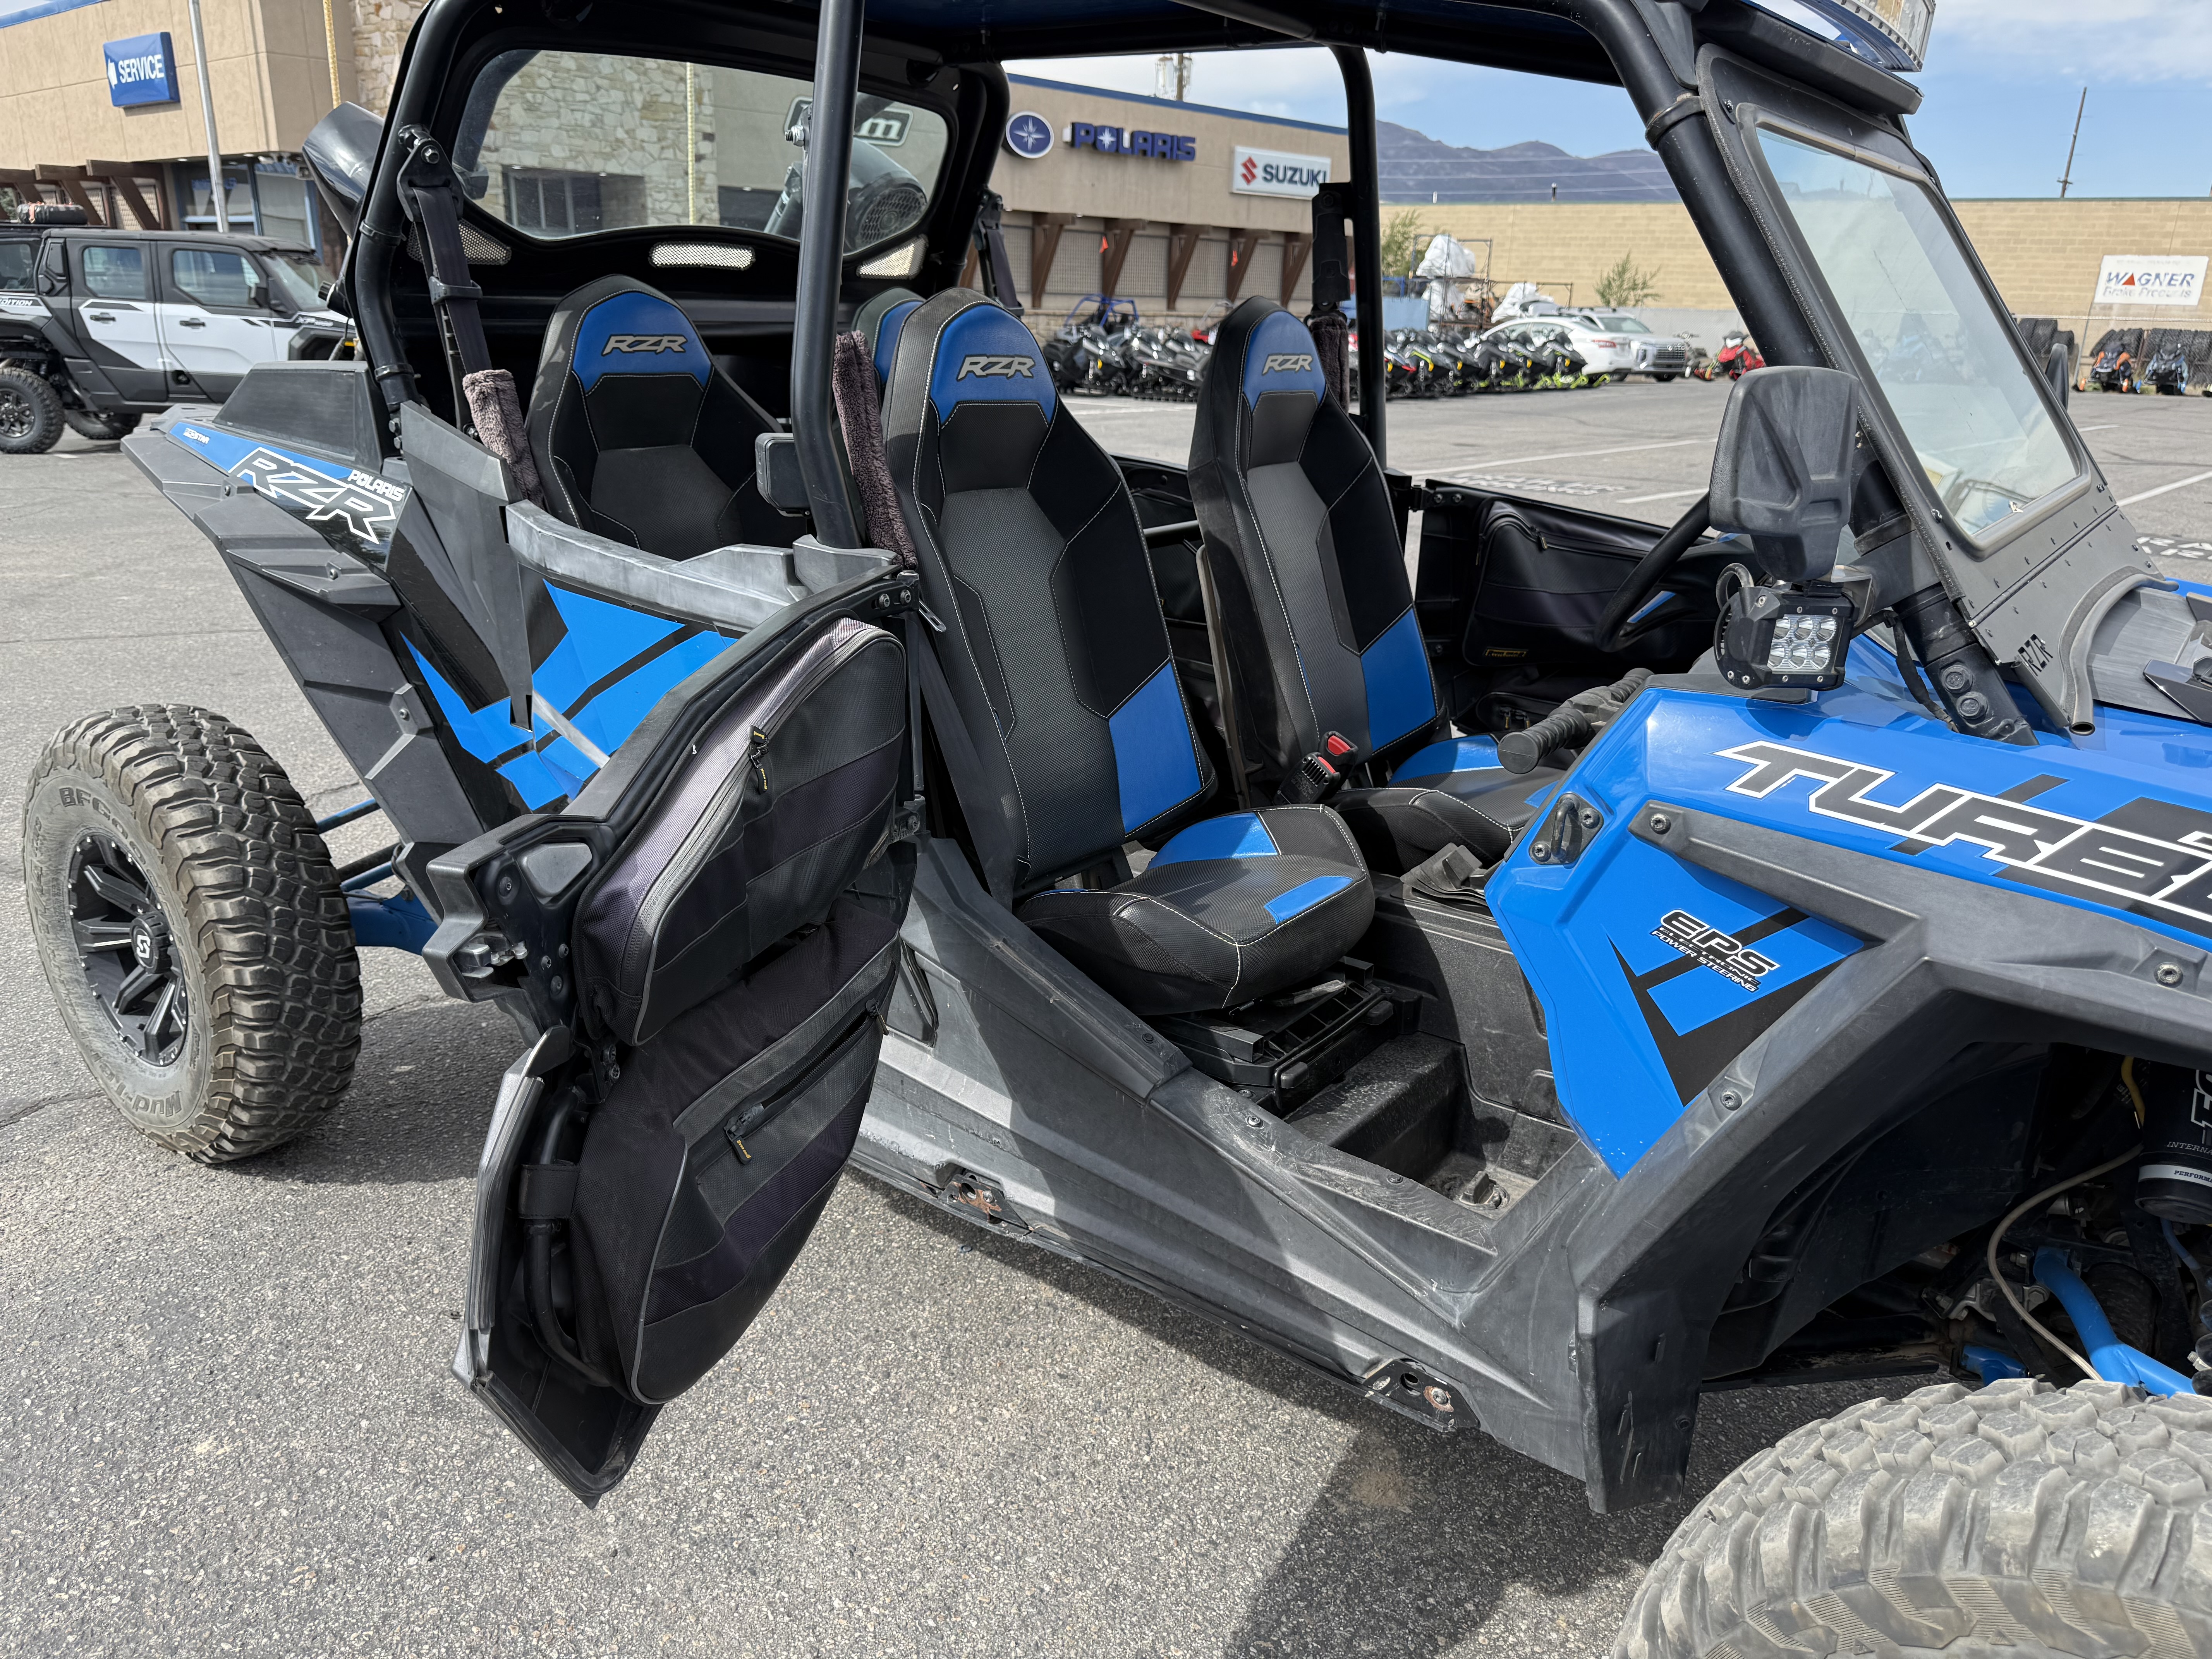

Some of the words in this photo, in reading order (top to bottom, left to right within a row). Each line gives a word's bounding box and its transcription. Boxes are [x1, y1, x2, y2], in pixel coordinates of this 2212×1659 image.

[118, 53, 165, 84] SERVICE
[1073, 122, 1196, 161] POLARIS
[1262, 163, 1326, 187] SUZUKI
[601, 334, 687, 356] RZR
[1262, 353, 1313, 375] RZR
[957, 354, 1036, 381] RZR
[228, 447, 396, 544] RZR
[348, 469, 405, 501] POLARIS
[2018, 634, 2053, 677] RZR
[1712, 740, 2212, 923] TURB
[1651, 930, 1697, 958] POWER
[1697, 956, 1757, 992] STEERING
[1659, 927, 1759, 985] ELECTRONIC
[1660, 909, 1781, 977] EPS
